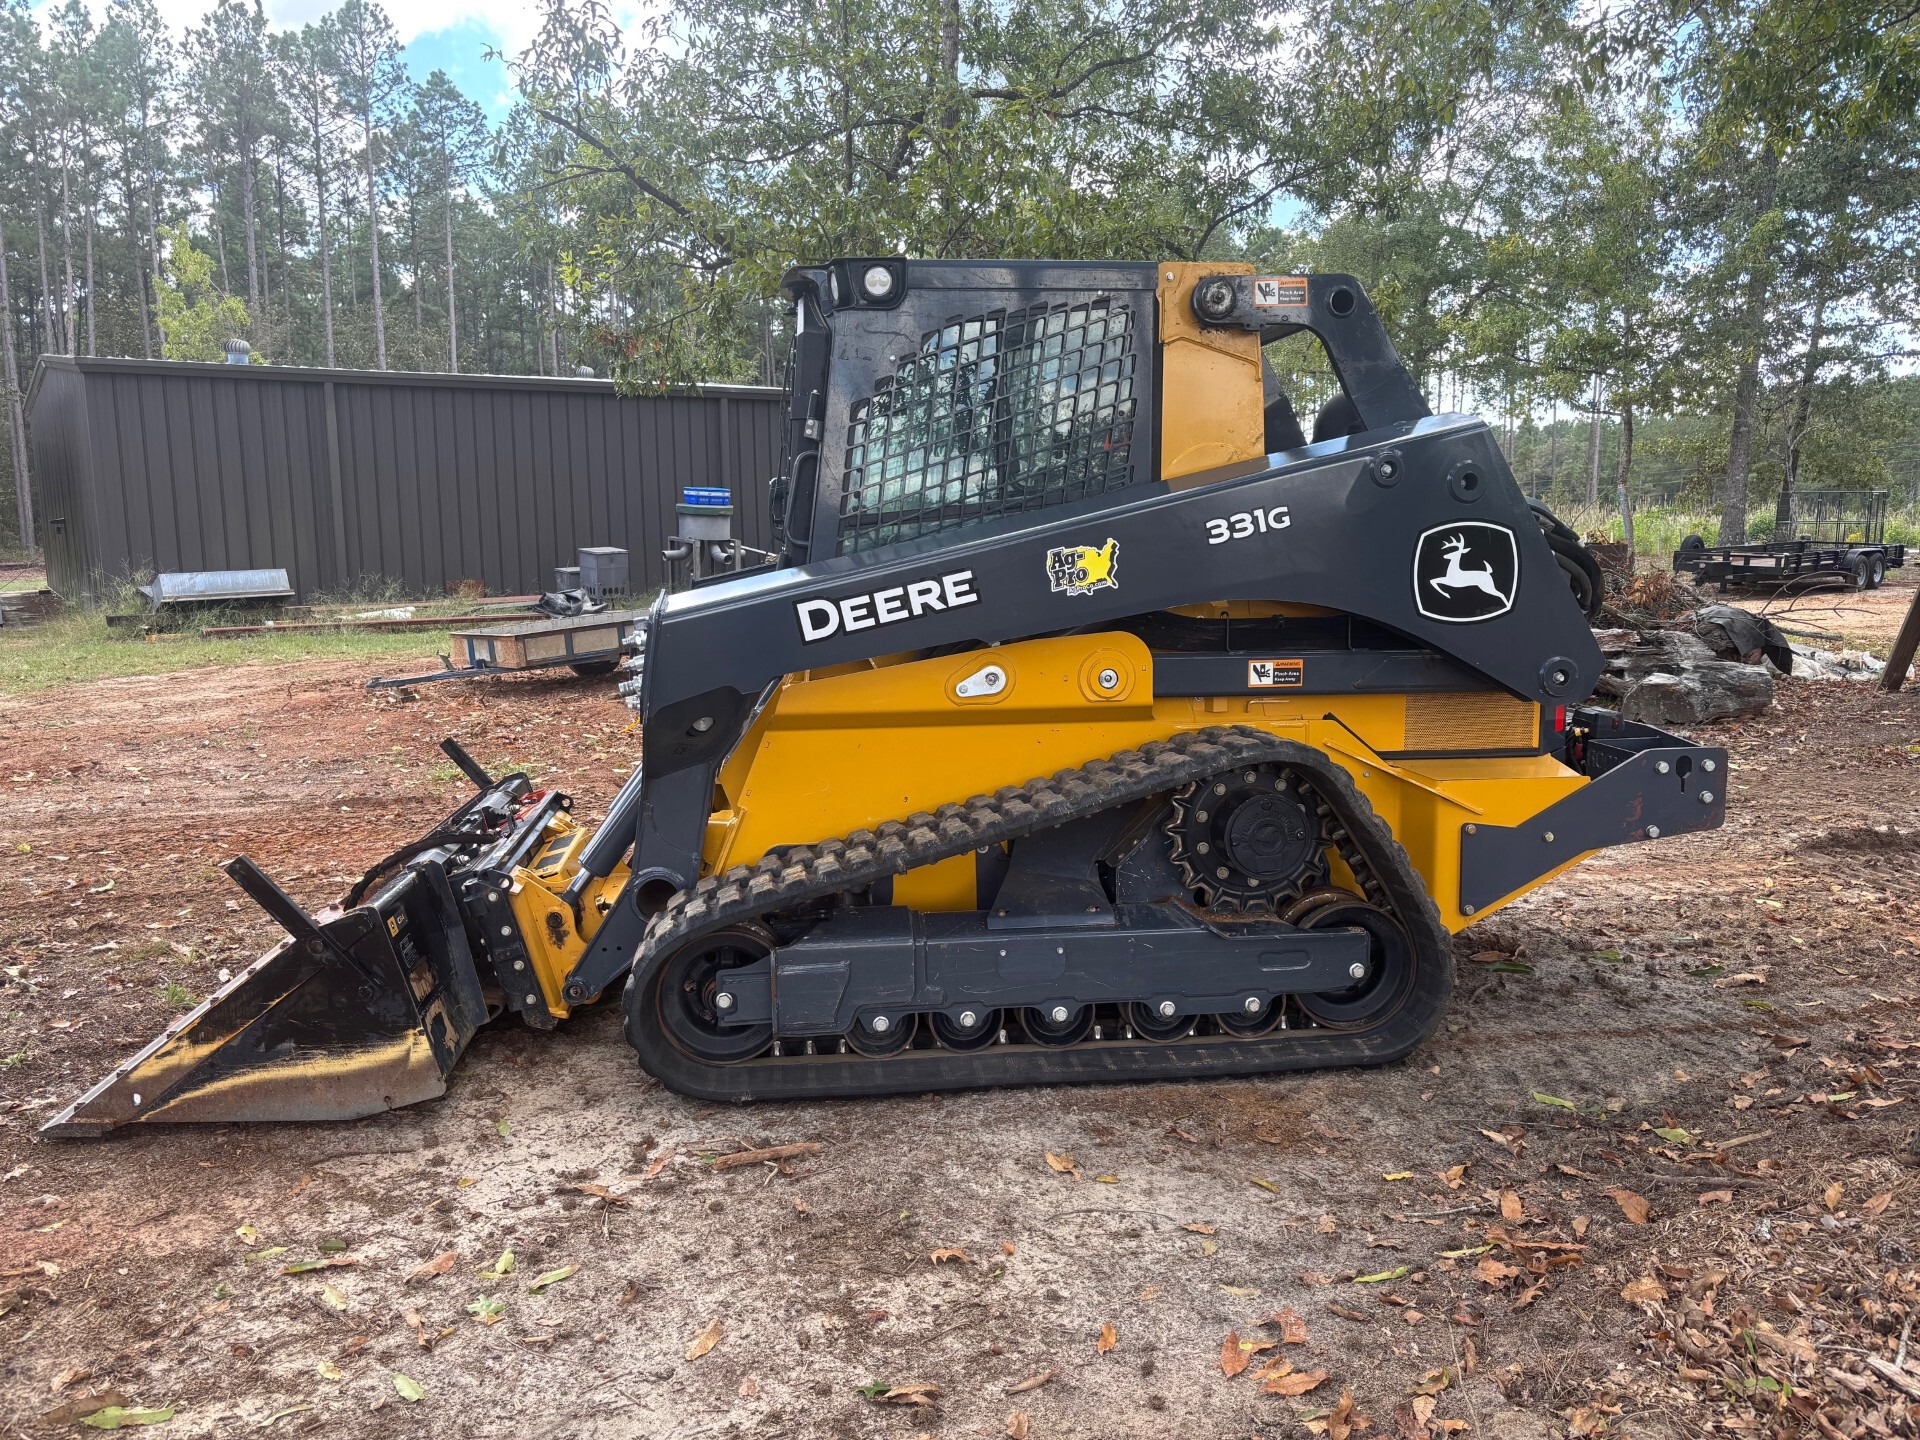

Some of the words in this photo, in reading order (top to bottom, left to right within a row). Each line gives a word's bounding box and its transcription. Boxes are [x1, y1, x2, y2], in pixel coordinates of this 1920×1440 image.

[1206, 506, 1291, 544] 331G
[1051, 551, 1084, 571] Ag-
[1053, 568, 1088, 588] Pro
[796, 570, 978, 642] DEERE
